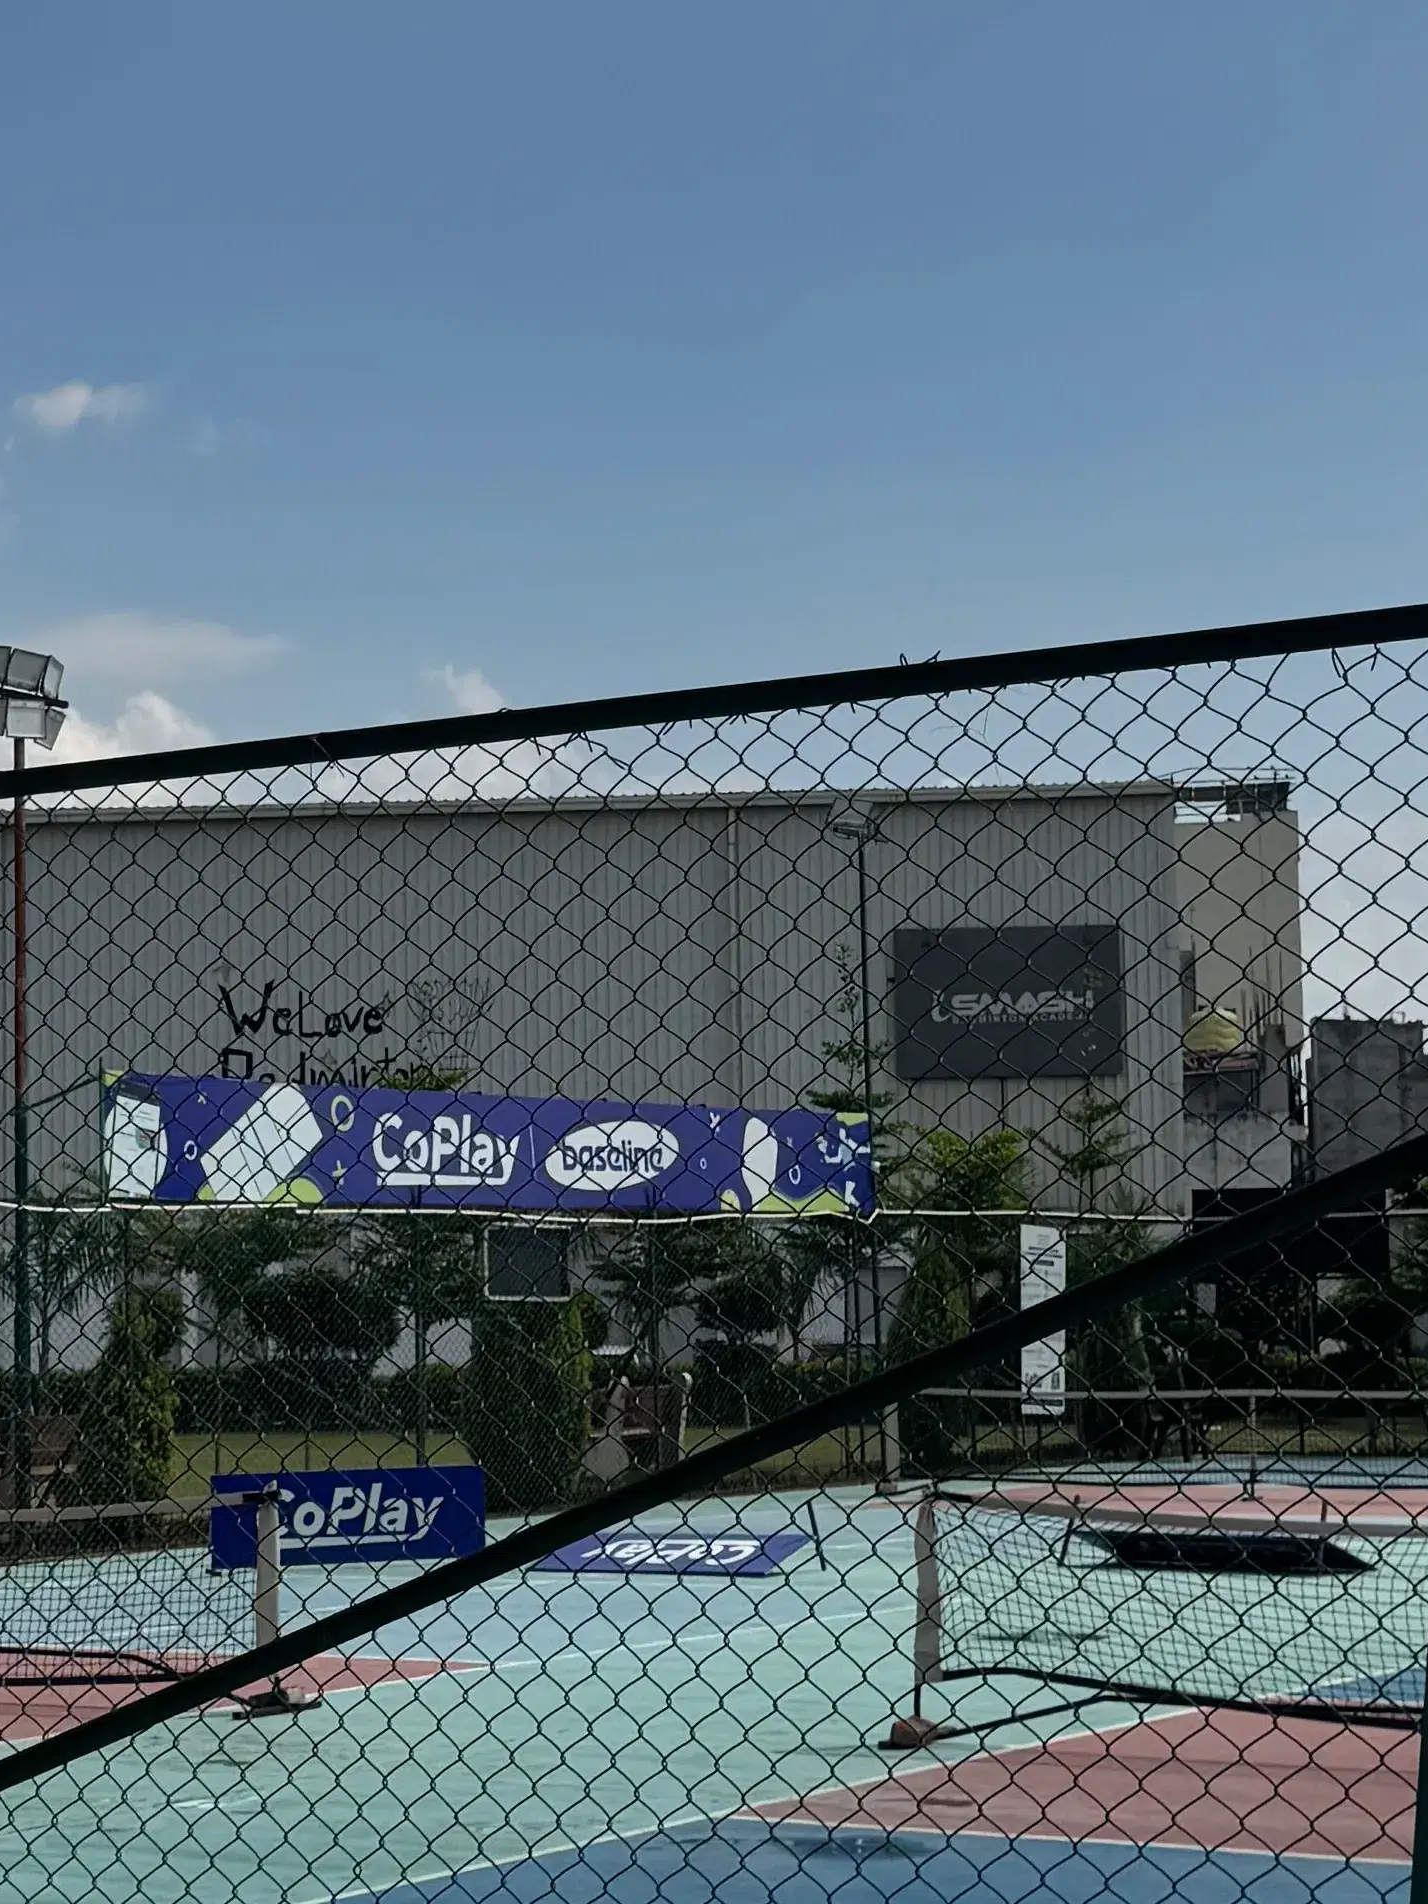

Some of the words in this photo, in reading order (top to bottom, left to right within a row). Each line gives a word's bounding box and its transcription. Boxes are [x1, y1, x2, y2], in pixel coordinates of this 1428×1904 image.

[950, 989, 1095, 1015] SMASH
[951, 1013, 1027, 1026] BMINTON
[1030, 1011, 1095, 1026] ACADE
[372, 1112, 520, 1186] CoPlay
[561, 1136, 665, 1174] baseline
